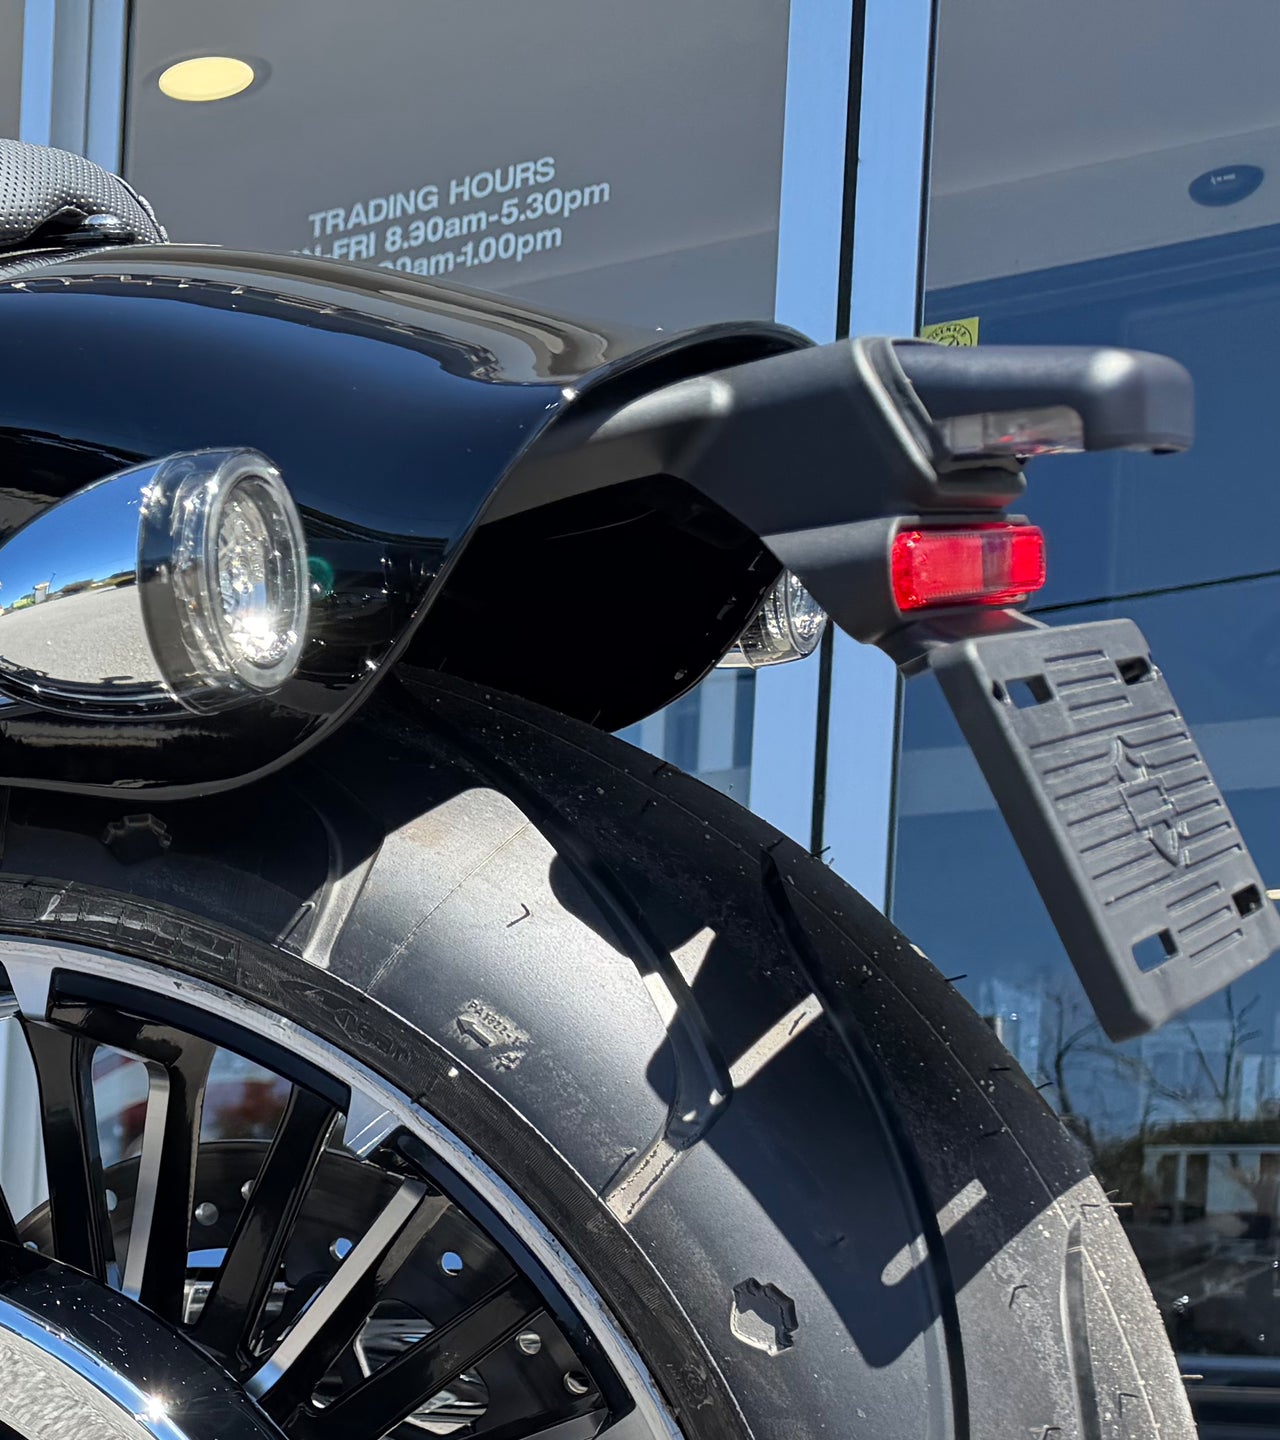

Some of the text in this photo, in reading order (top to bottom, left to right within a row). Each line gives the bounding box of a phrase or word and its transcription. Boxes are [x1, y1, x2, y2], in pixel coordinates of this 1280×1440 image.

[309, 156, 556, 238] TRADING HOURS
[384, 181, 611, 253] 8.30am-5.30pm
